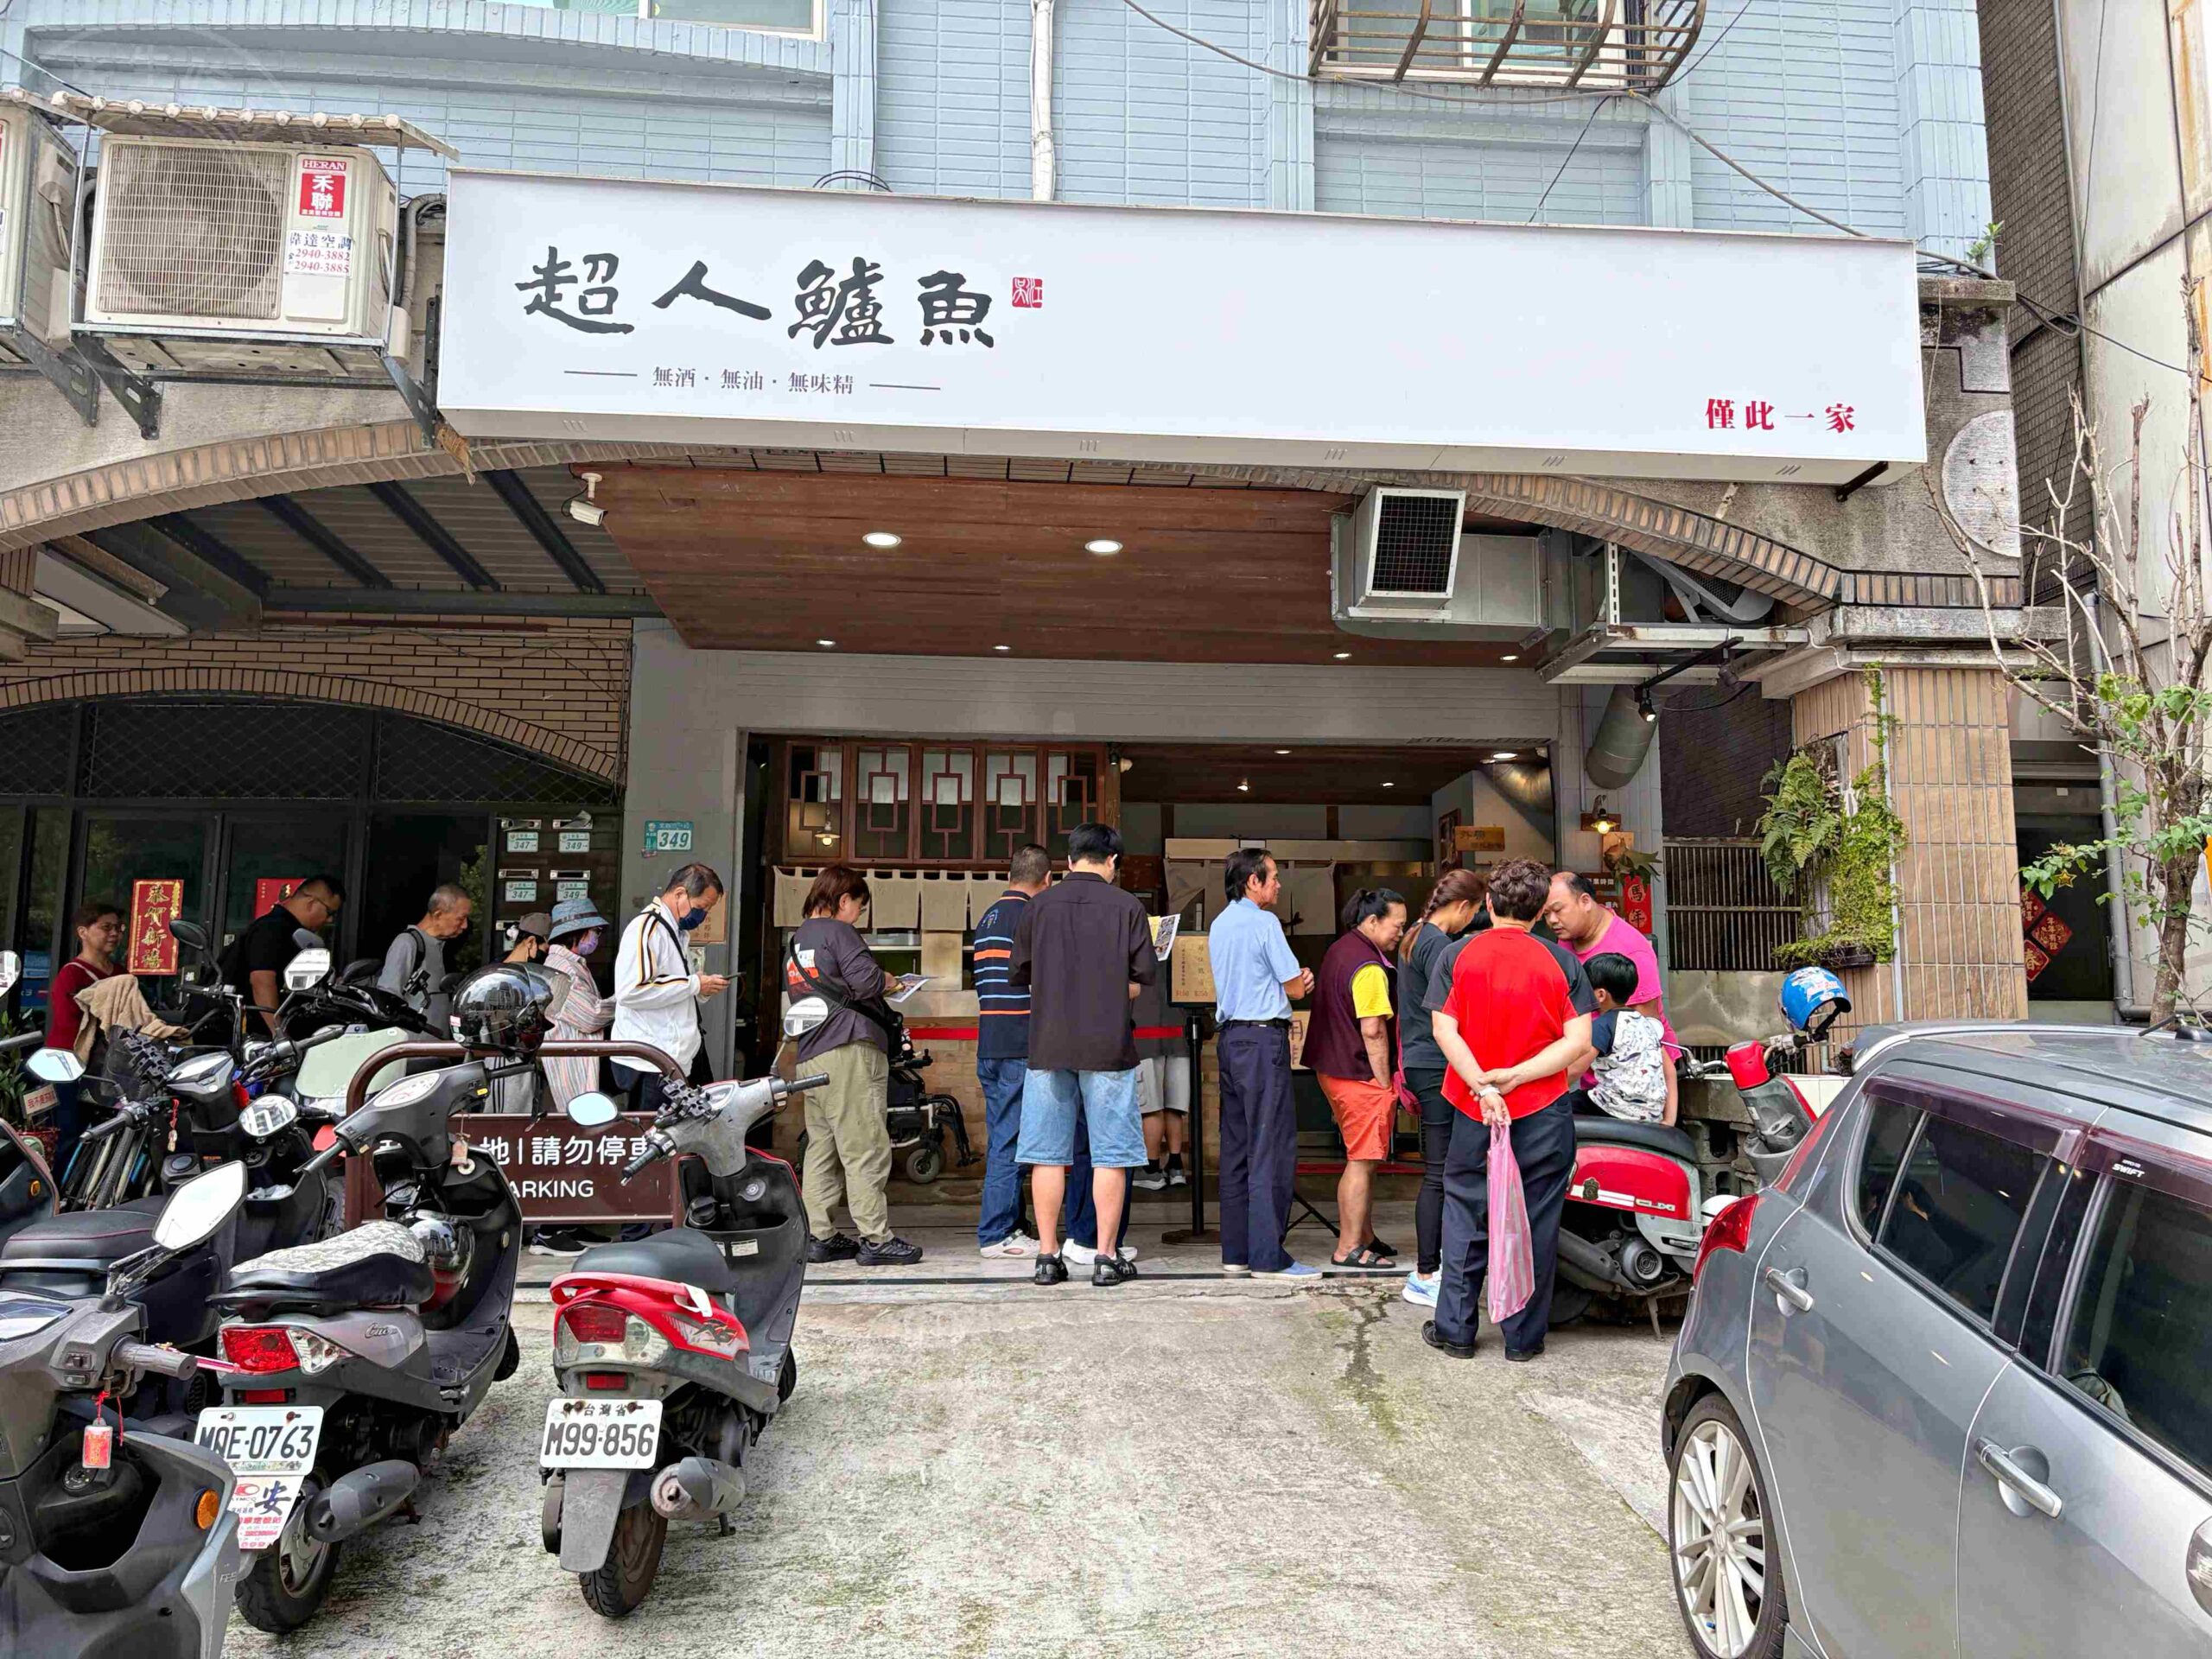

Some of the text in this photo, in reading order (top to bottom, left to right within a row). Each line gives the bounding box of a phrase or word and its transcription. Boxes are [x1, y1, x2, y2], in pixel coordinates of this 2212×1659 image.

[303, 160, 346, 171] HERAN
[311, 175, 334, 211] 禾聯
[295, 248, 351, 262] 2940-3882
[294, 260, 350, 274] 2940-3885
[514, 245, 995, 349] 超人鱸魚
[1705, 398, 1856, 434] 僅此一家
[514, 841, 530, 849] 347
[565, 842, 582, 850] 349
[659, 831, 690, 848] 349
[512, 891, 528, 899] 347
[563, 891, 580, 899] 349
[1630, 884, 1646, 929] 馬年
[2112, 1163, 2145, 1178] SWIFT
[509, 1179, 594, 1198] ARKING
[583, 1403, 626, 1417] 台灣省
[254, 1480, 292, 1516] 安
